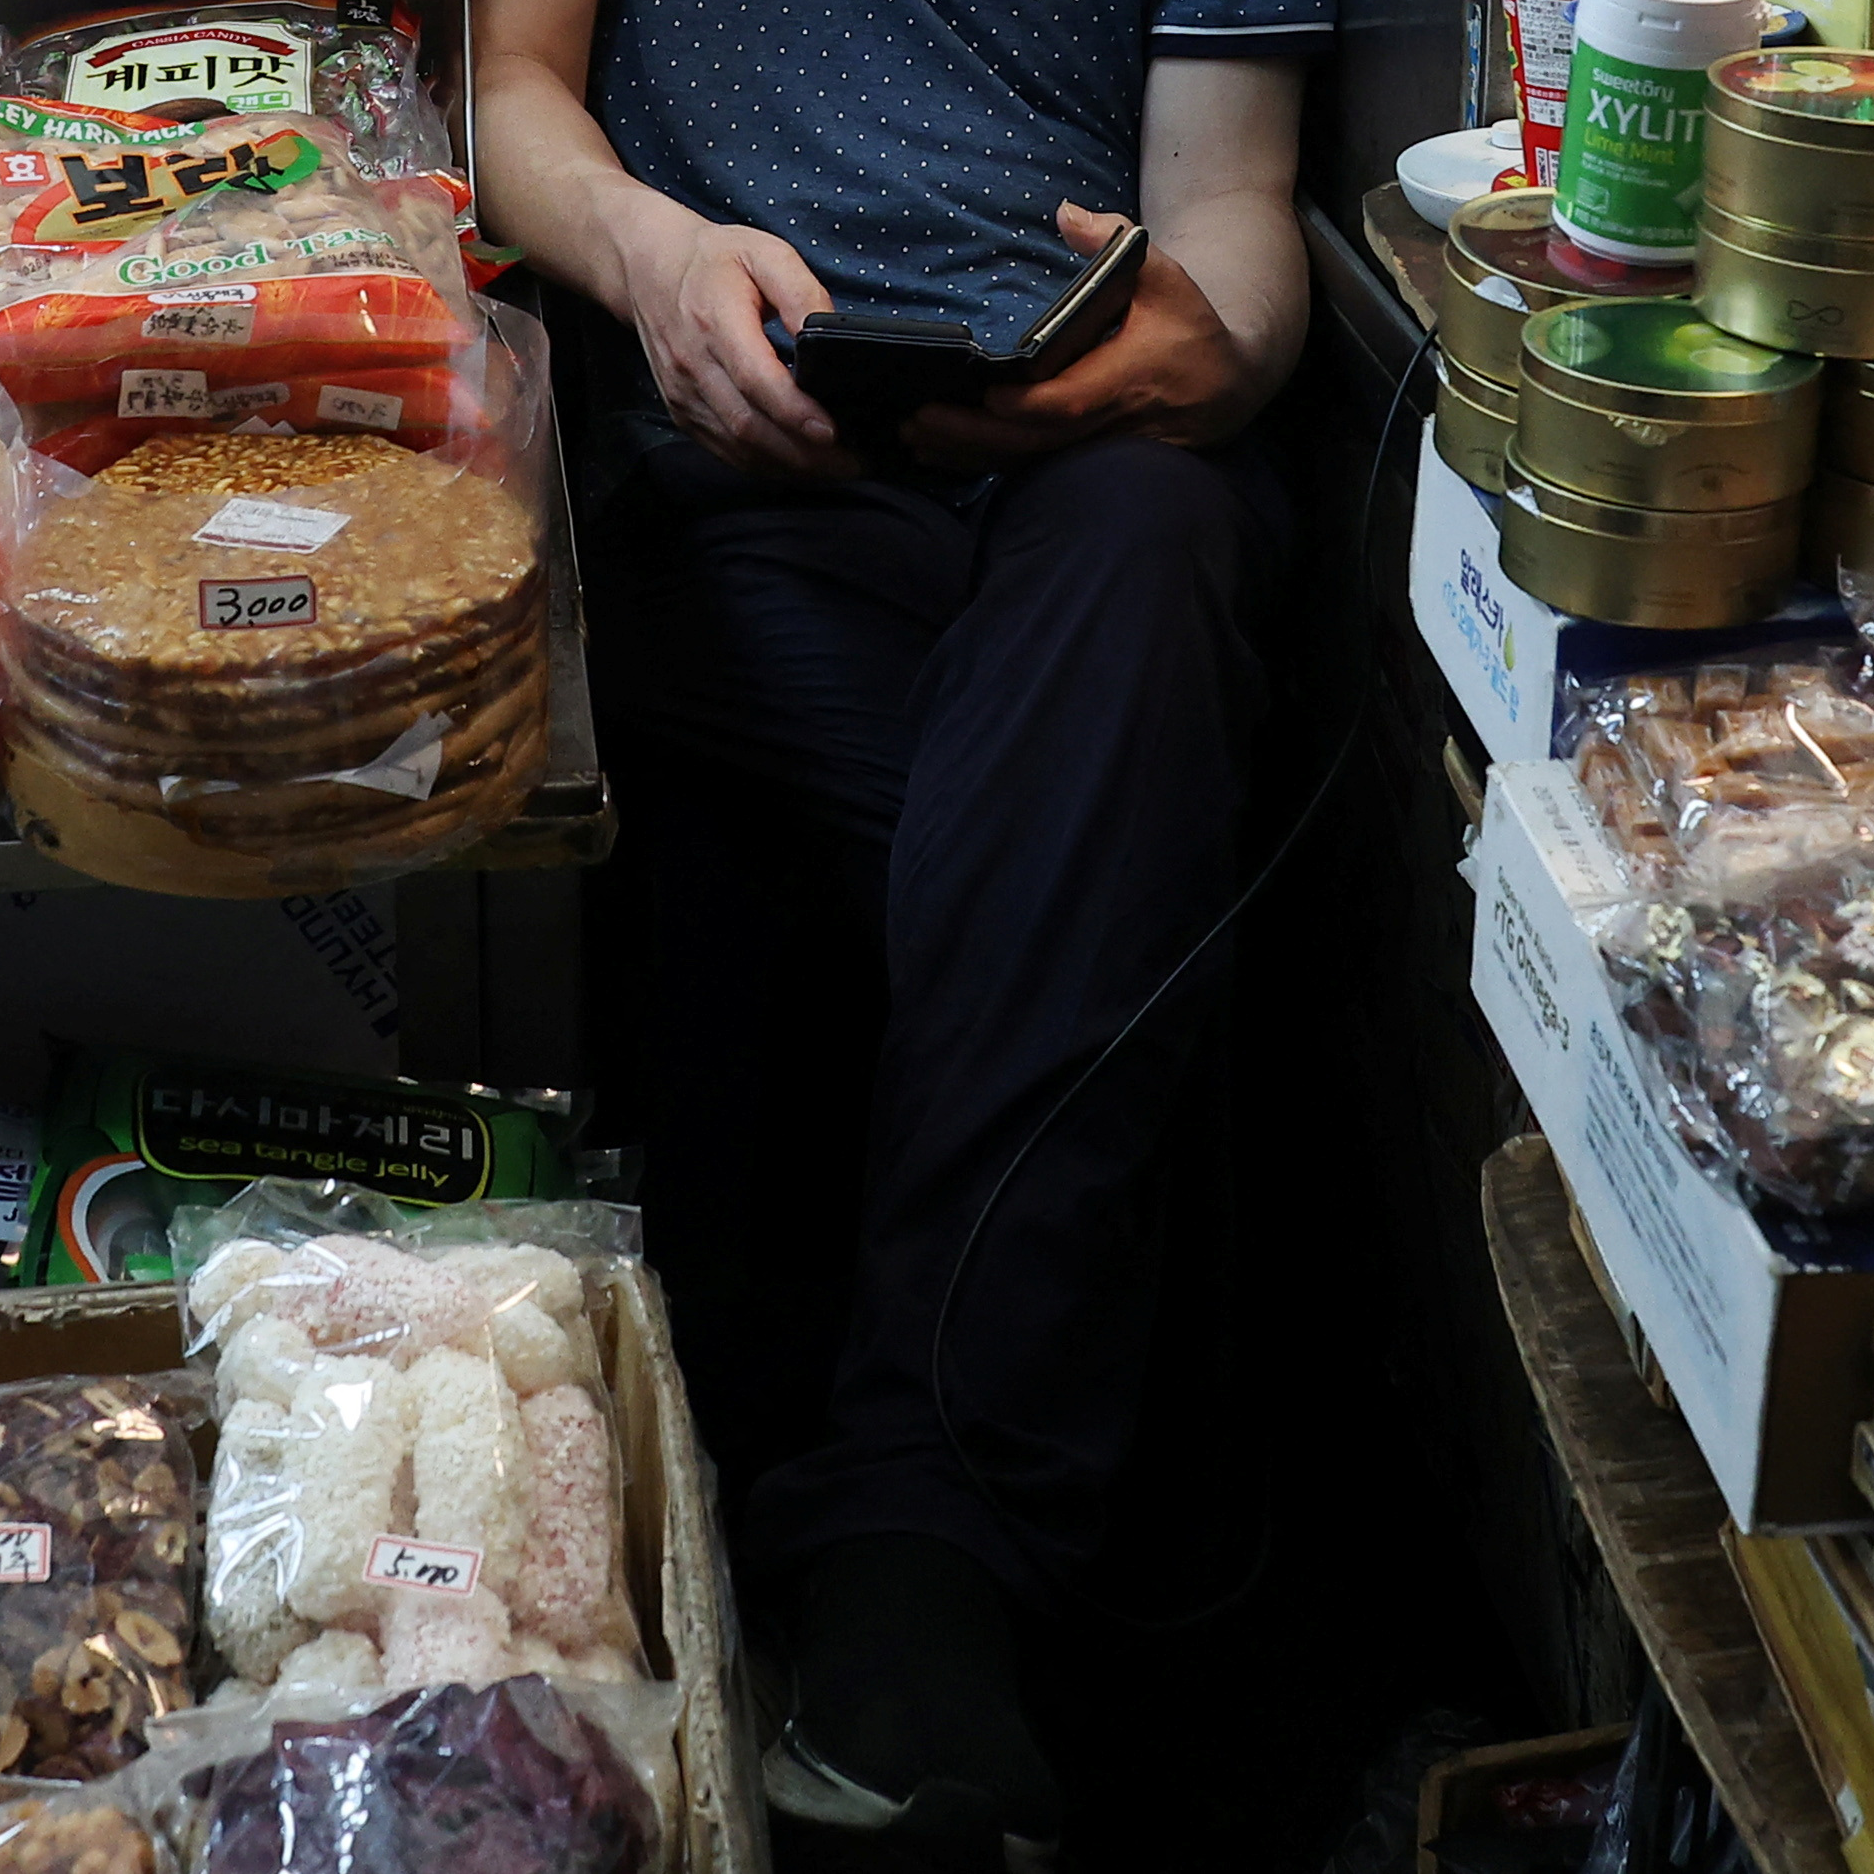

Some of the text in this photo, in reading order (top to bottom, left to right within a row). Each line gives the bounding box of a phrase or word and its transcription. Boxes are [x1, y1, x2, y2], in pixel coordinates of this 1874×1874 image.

[131, 28, 253, 50] CASSIA CANDY
[85, 55, 297, 92] 계피맛
[228, 91, 291, 109] 캔디
[41, 114, 197, 146] HARD TACK
[1583, 127, 1676, 165] Lime Mint
[118, 229, 274, 287] Good
[177, 1134, 449, 1190] sea tangle jelly
